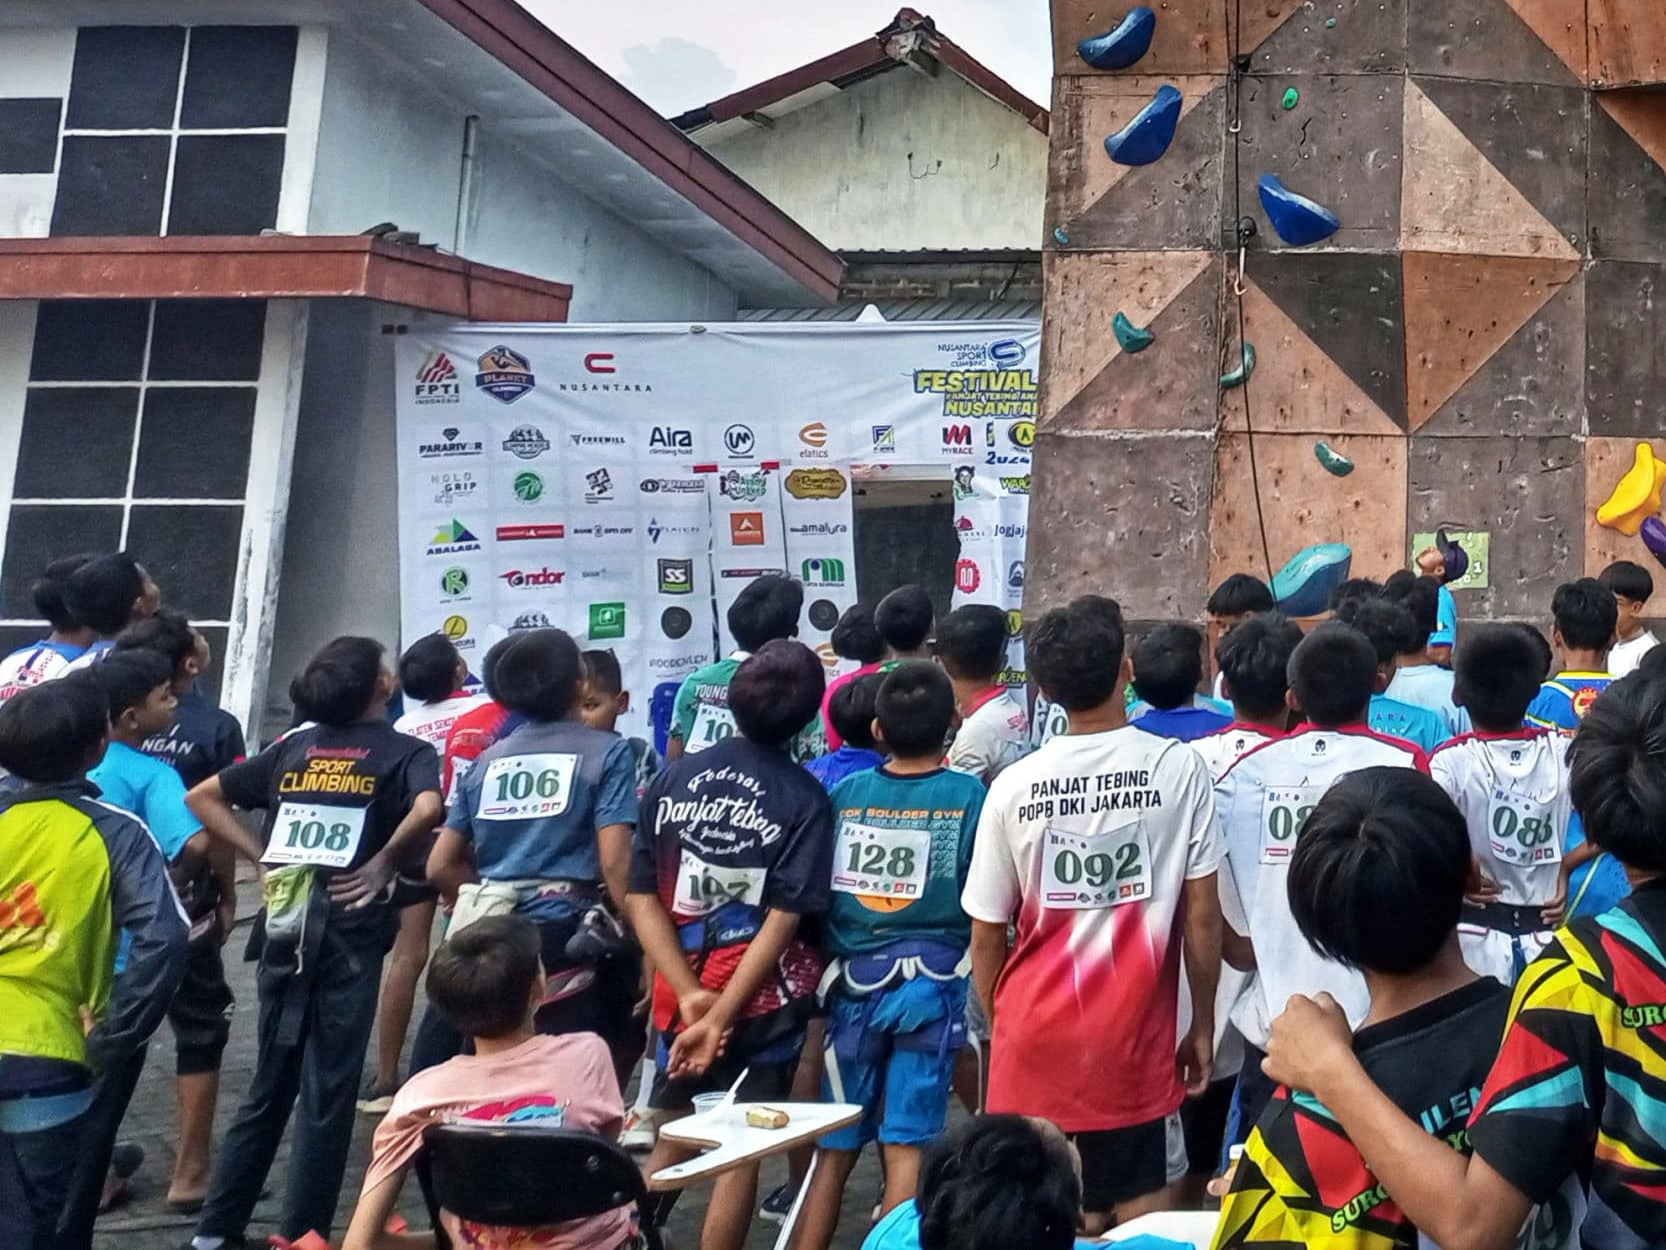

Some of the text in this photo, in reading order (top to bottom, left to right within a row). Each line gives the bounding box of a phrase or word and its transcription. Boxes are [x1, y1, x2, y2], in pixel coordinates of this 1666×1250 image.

[415, 384, 459, 395] FPTI
[560, 384, 652, 392] NUSANTARA
[916, 370, 1037, 392] FESTIVAL
[649, 427, 692, 447] Aira
[799, 449, 829, 458] elatics
[445, 482, 477, 492] GRIP
[694, 684, 728, 699] YOUNG
[703, 719, 734, 742] 10
[307, 759, 355, 773] SPORT
[279, 772, 376, 795] CLIMBING
[496, 769, 560, 801] 106
[1031, 770, 1149, 800] PANJAT TEBING
[866, 808, 929, 819] BOULDER
[933, 810, 964, 819] GYM
[1019, 790, 1161, 824] POPB DKI JAKARTA
[284, 820, 352, 852] 108
[846, 841, 915, 878] 128
[1054, 842, 1142, 887] 092
